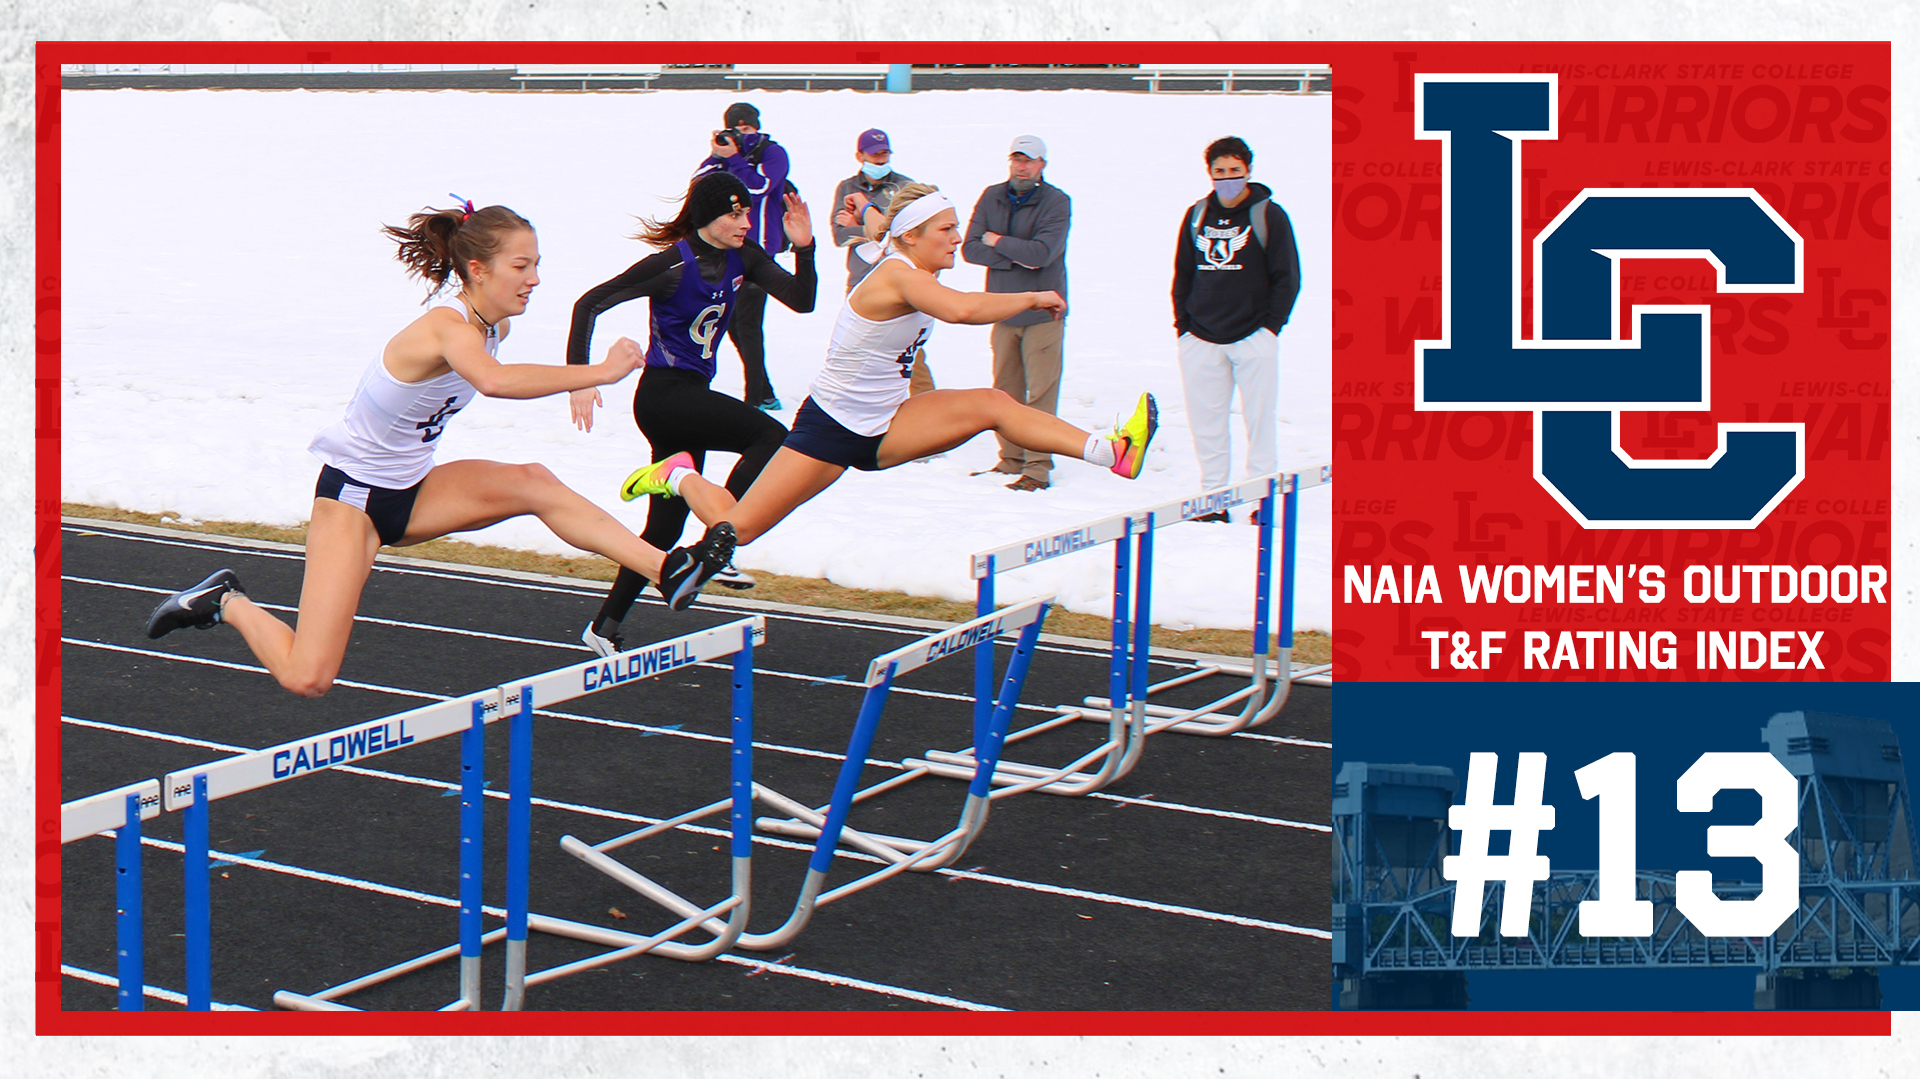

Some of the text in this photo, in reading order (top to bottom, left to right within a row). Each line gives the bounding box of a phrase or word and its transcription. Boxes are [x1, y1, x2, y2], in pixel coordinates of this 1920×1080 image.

[1180, 486, 1245, 519] CALDWELL
[1024, 526, 1096, 564] CALDWELL
[925, 616, 1005, 662] CALDWELL
[583, 641, 697, 692] CALDWELL
[272, 718, 415, 781] CALDWELL
